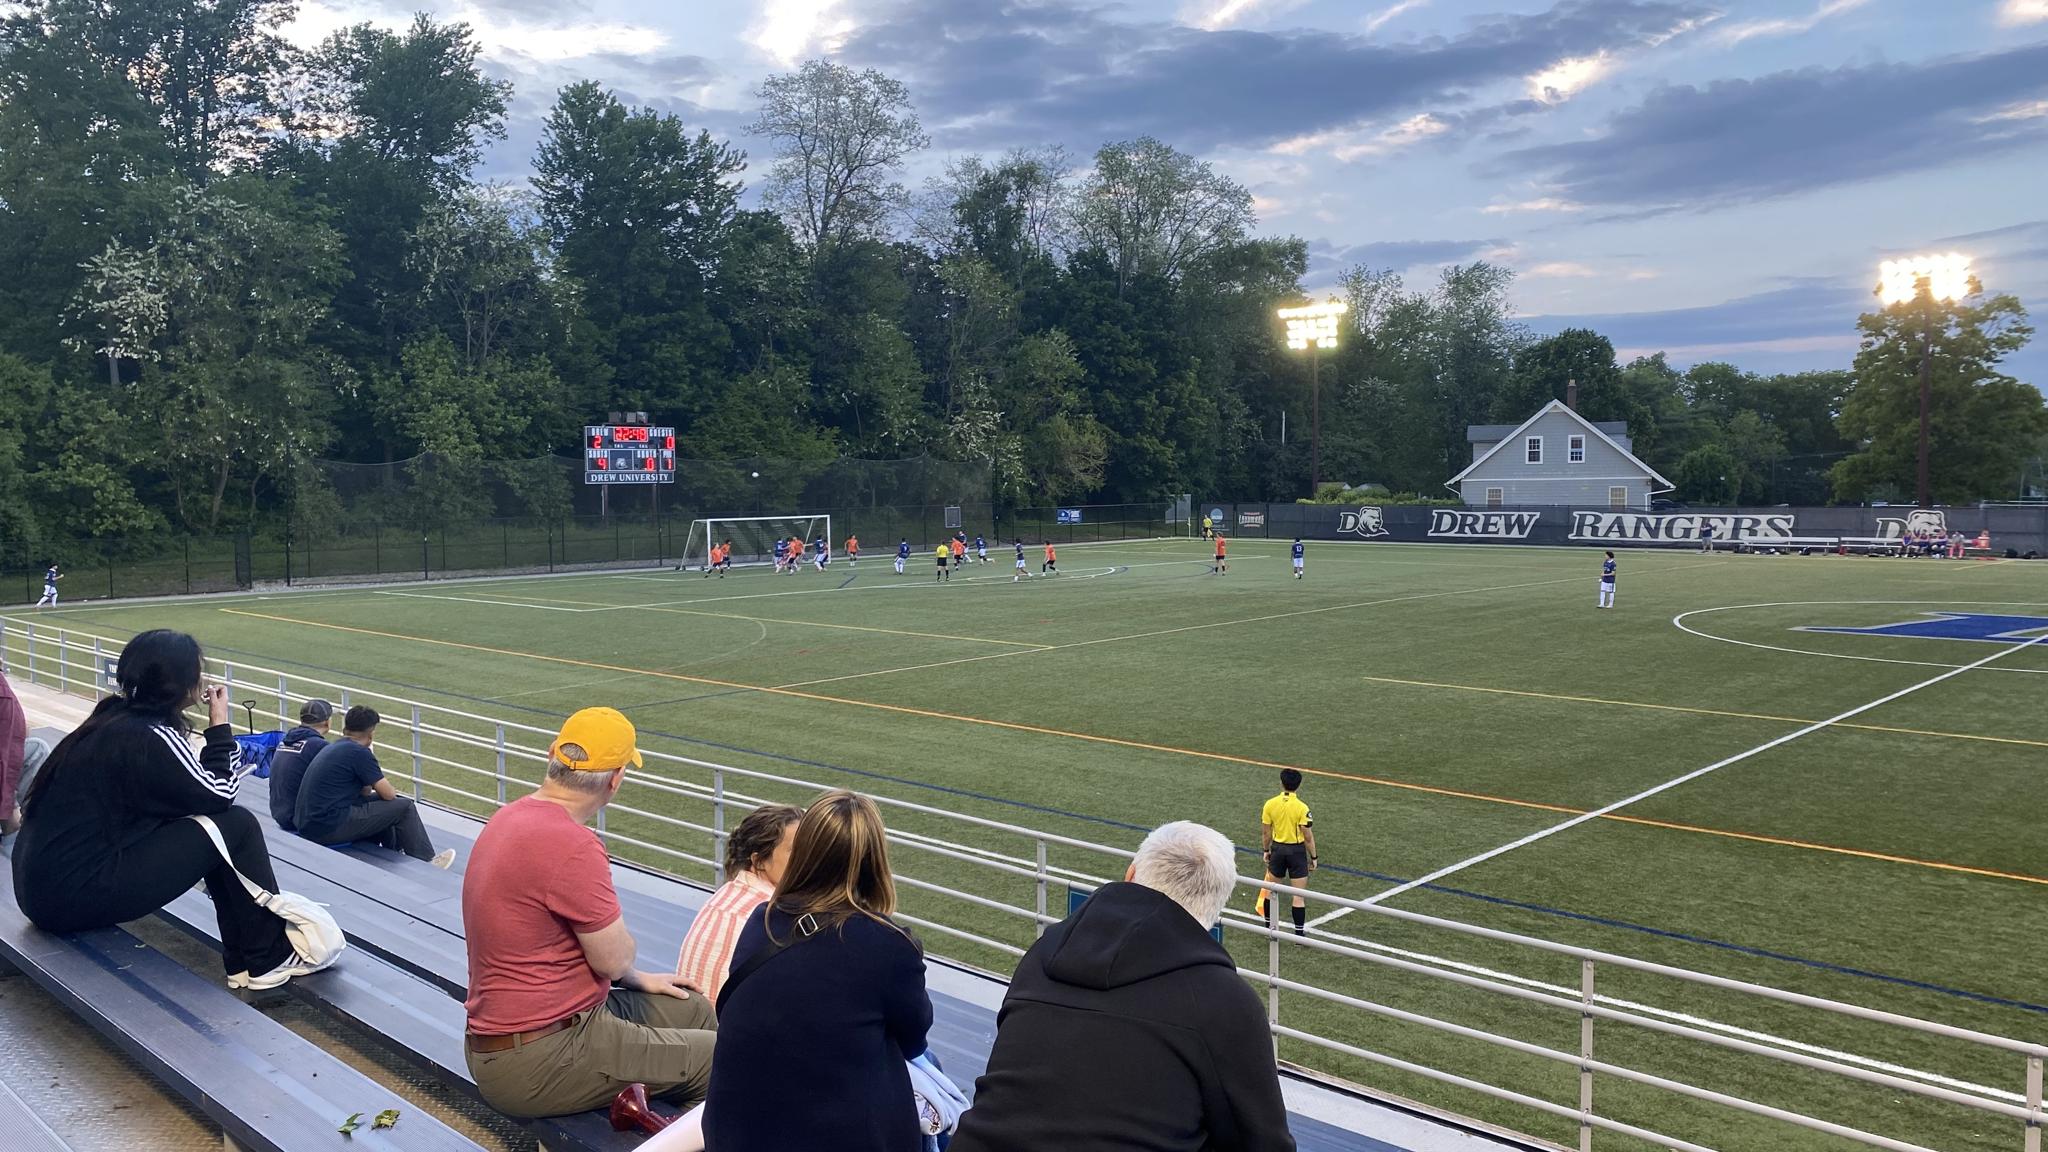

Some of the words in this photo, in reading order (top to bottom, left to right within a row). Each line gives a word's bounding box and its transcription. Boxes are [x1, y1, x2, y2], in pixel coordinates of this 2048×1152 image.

[615, 428, 647, 441] 22:48
[649, 428, 672, 437] GUESTS
[593, 435, 602, 448] 2
[666, 436, 675, 449] 0
[646, 457, 655, 471] 0
[591, 473, 616, 482] DREW
[619, 473, 669, 482] UNIVERSITY
[1428, 509, 1541, 539] DREW
[1567, 511, 1795, 542] RANGERS
